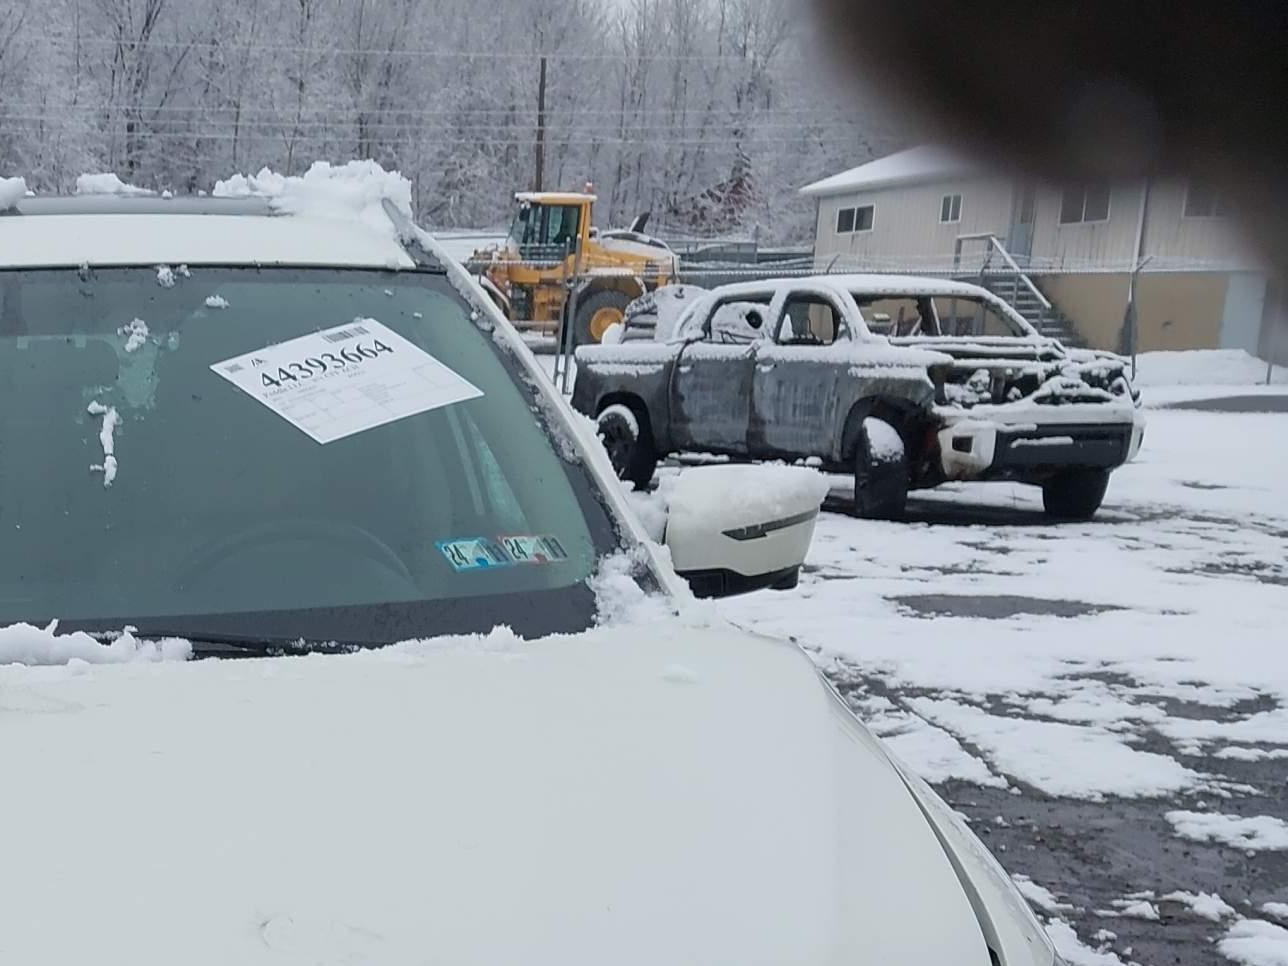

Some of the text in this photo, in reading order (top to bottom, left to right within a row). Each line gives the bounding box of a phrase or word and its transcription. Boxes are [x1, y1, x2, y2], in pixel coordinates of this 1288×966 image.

[261, 338, 394, 389] 44393664
[443, 543, 470, 567] 24
[504, 537, 529, 560] 24
